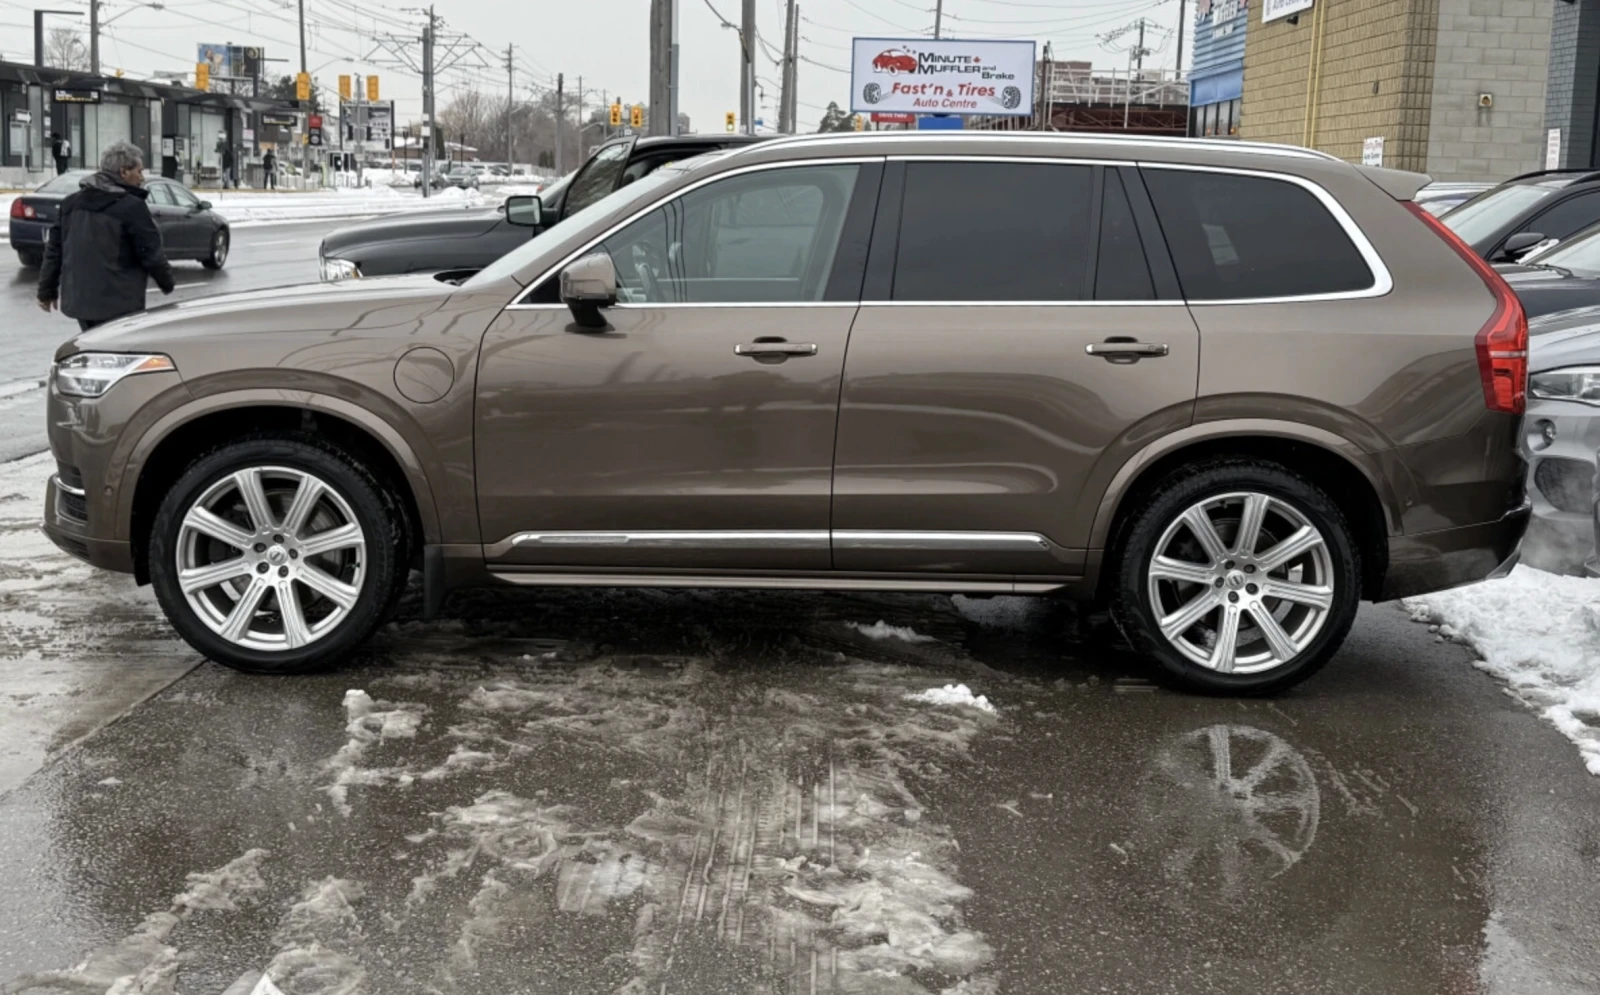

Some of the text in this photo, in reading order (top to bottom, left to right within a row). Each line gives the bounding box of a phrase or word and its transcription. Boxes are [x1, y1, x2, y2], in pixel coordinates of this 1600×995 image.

[918, 52, 972, 63] MINUTE
[918, 64, 981, 75] MUFFLER
[981, 72, 1015, 80] Brake
[891, 82, 996, 97] Fast'n & Tires
[912, 98, 977, 109] Auto Centre
